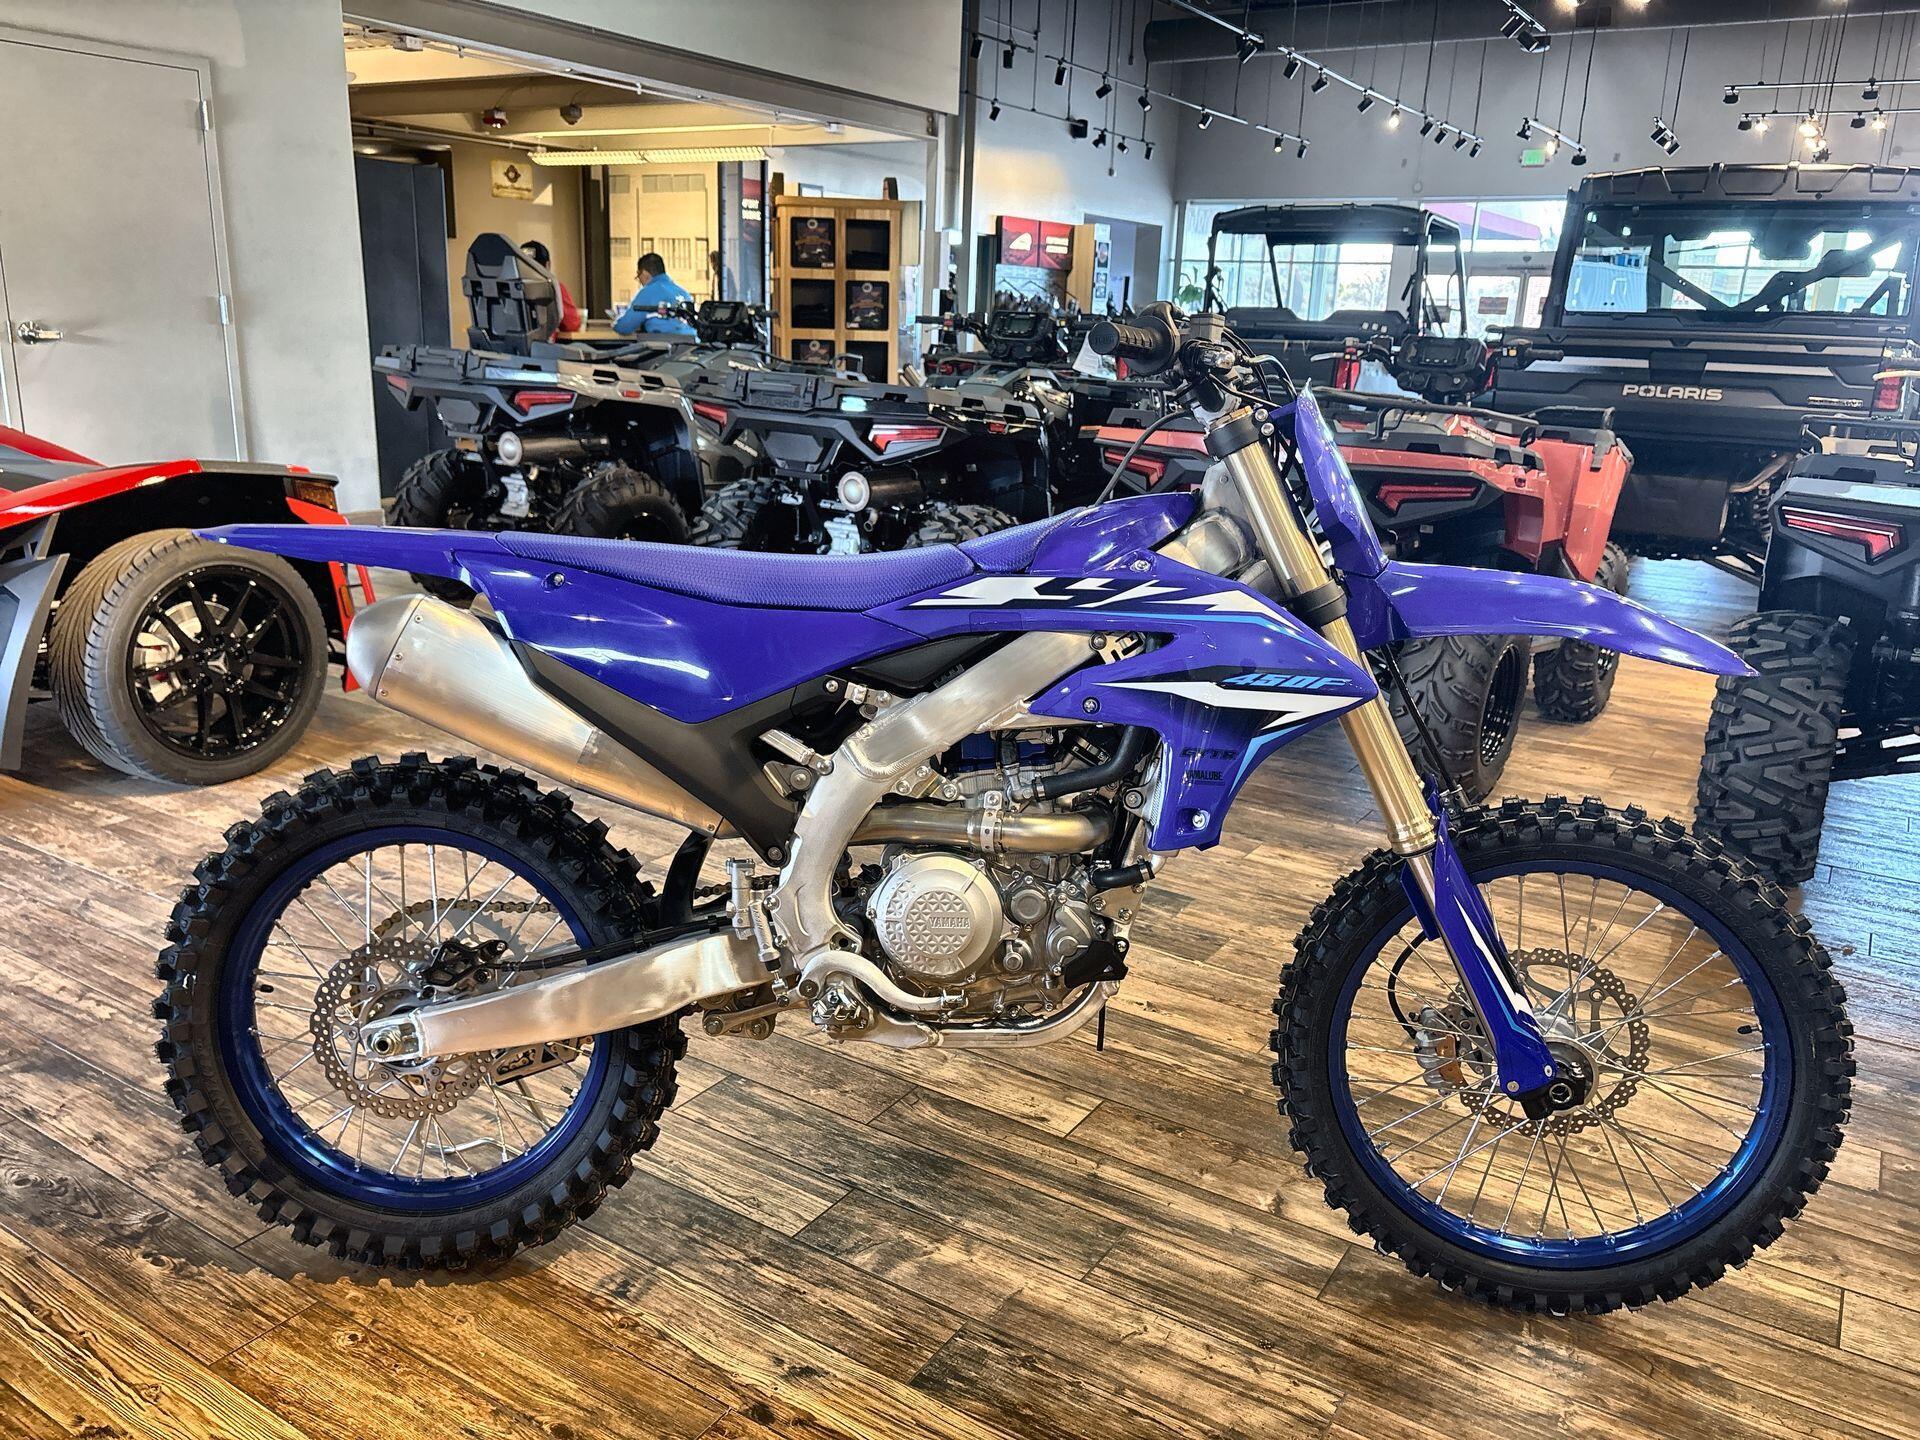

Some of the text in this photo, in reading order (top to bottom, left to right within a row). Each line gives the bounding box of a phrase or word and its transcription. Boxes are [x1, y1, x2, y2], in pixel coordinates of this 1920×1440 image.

[1622, 384, 1723, 401] POLARIS
[1222, 673, 1353, 689] 450F
[929, 916, 971, 929] YAMAHA
